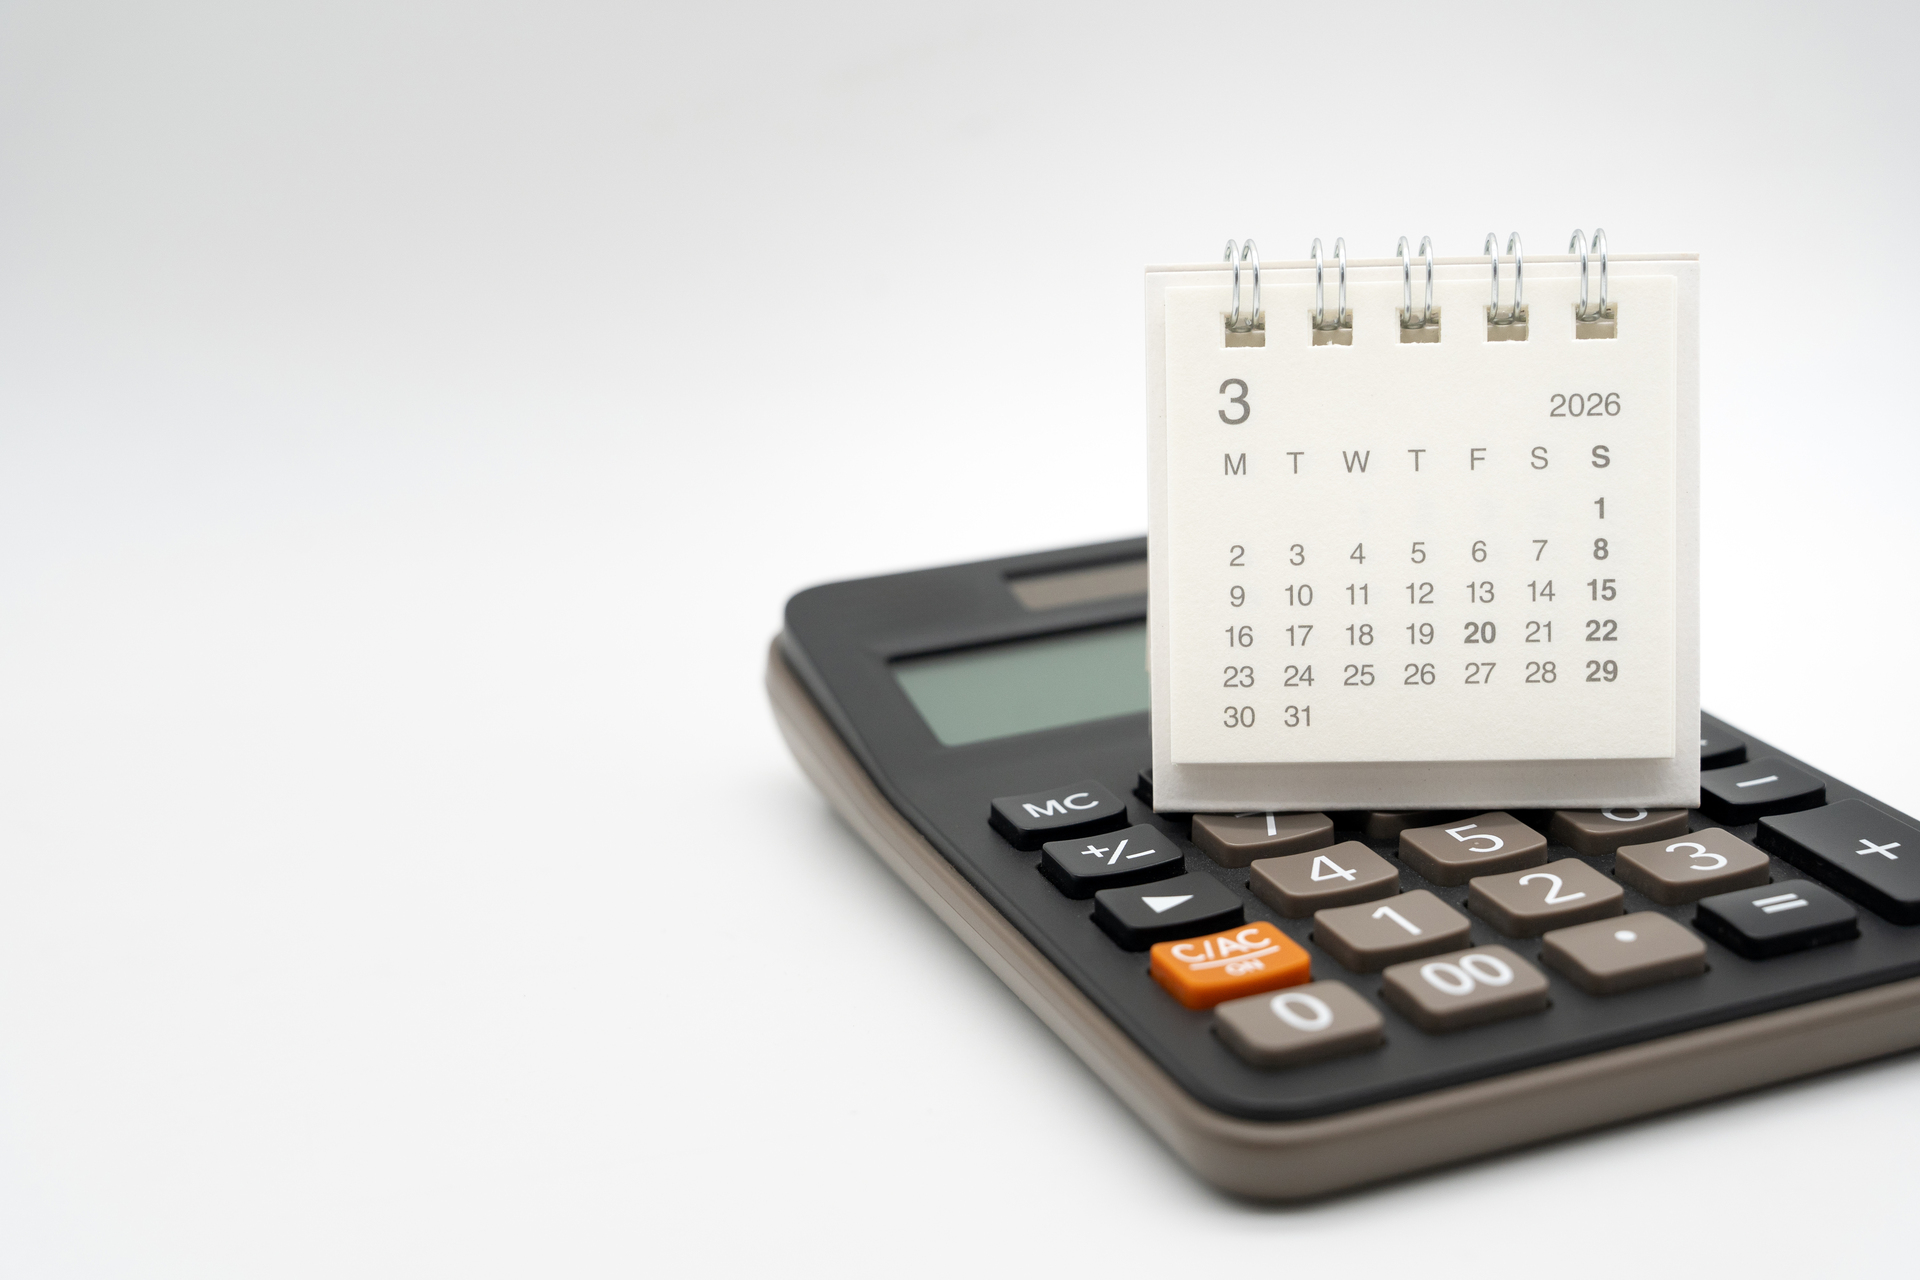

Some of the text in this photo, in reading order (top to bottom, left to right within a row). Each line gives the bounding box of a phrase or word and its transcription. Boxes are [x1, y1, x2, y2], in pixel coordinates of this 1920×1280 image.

[1218, 378, 1251, 426] 3
[1549, 392, 1621, 418] 2026
[1224, 444, 1611, 476] M T W T F S S
[1594, 496, 1605, 520] 1
[1229, 537, 1609, 567] 2 3 4 5 6 7 8
[1229, 578, 1617, 608] 9 10 11 12 13 14 15
[1225, 619, 1618, 648] 16 17 18 19 20 21 22
[1223, 659, 1619, 689] 23 24 25 26 27 28 29
[1223, 705, 1312, 729] 30 31
[1021, 791, 1100, 819] MC
[1444, 822, 1505, 854] 5
[1309, 854, 1358, 883] 4
[1664, 841, 1728, 872] 3
[1518, 872, 1587, 906] 2
[1371, 904, 1423, 937] 1
[1170, 927, 1272, 964] C/AC
[1419, 953, 1515, 996] 00
[1269, 991, 1334, 1032] 0
